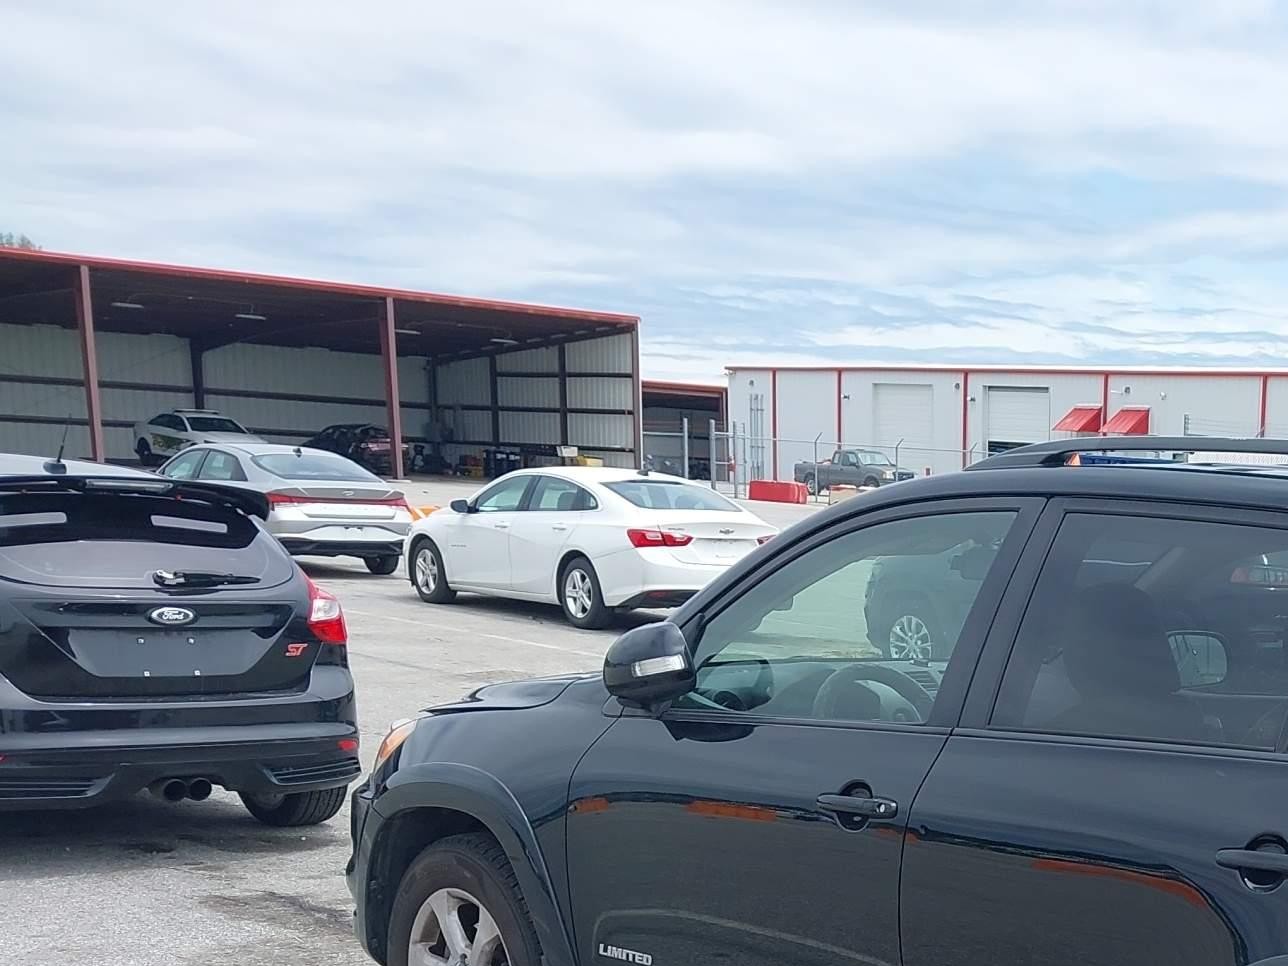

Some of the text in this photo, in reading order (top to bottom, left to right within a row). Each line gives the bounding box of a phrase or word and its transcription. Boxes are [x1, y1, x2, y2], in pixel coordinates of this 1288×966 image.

[161, 610, 185, 620] Ford
[285, 643, 308, 656] ST
[599, 943, 653, 966] LIMITED
